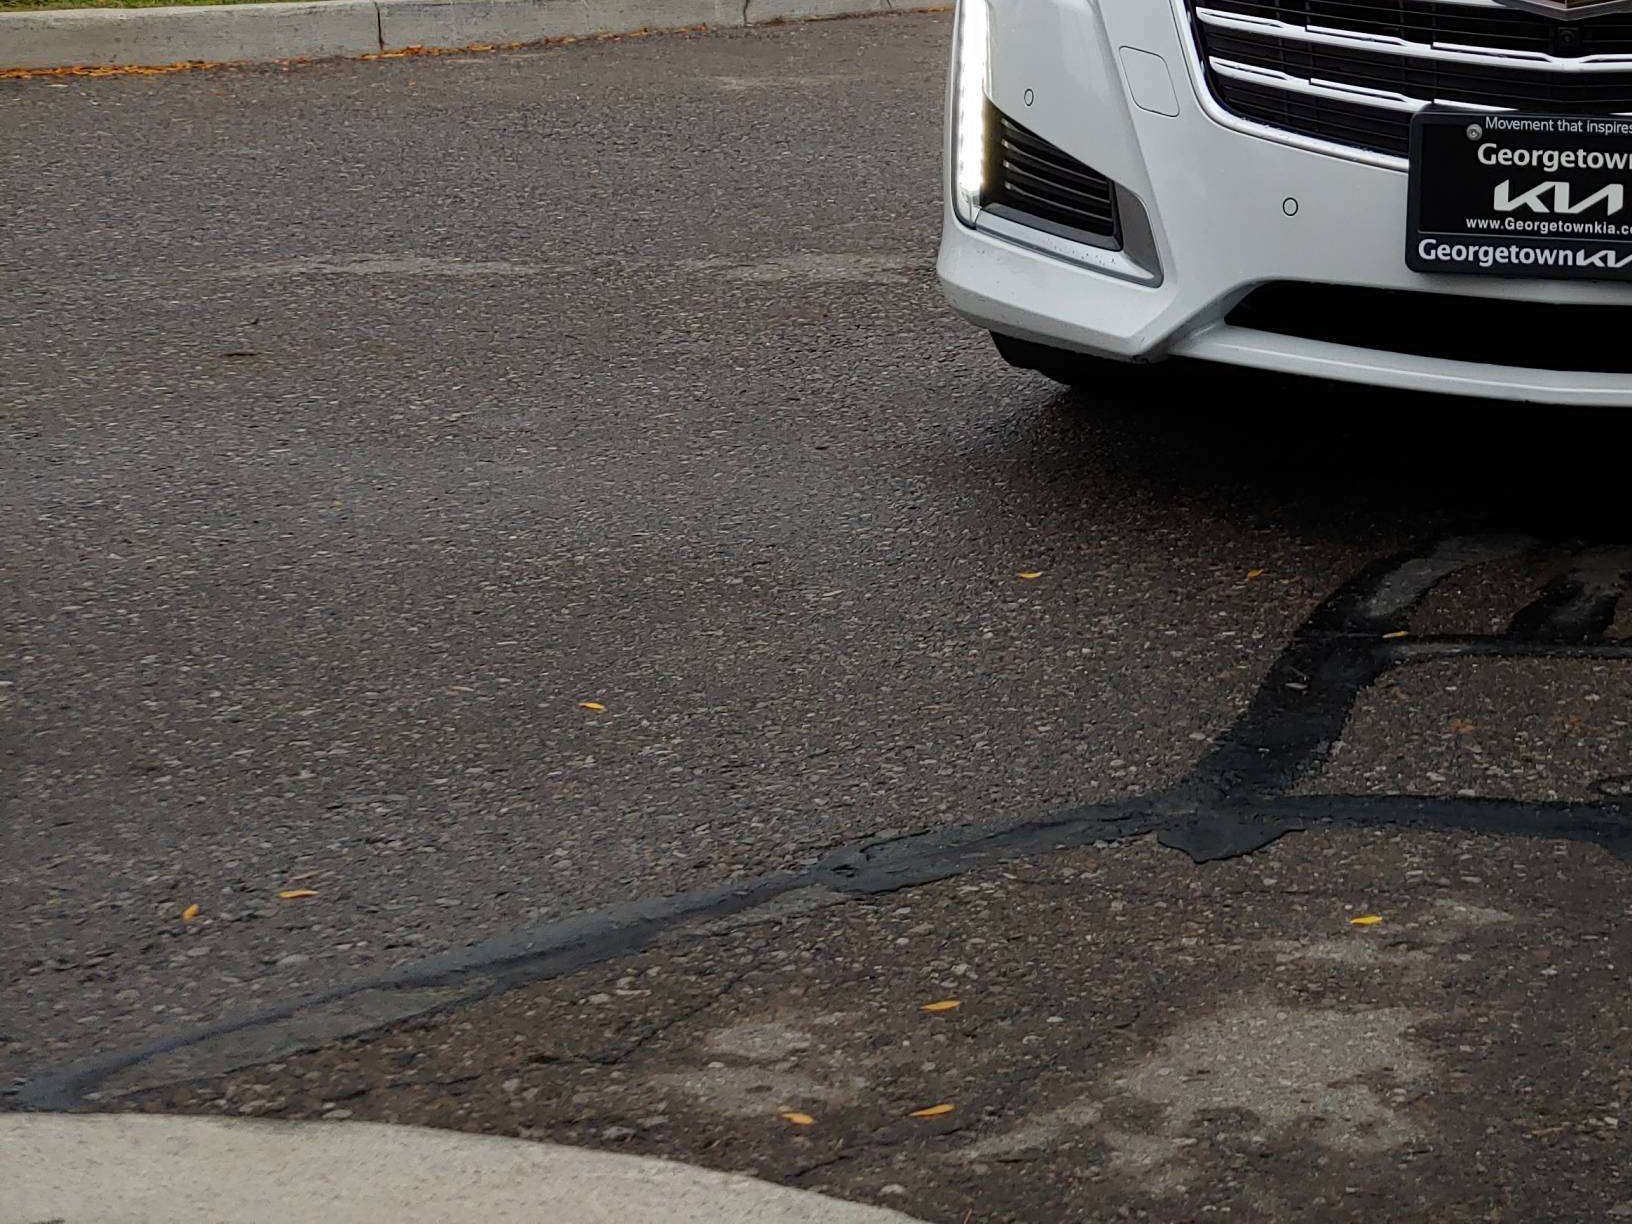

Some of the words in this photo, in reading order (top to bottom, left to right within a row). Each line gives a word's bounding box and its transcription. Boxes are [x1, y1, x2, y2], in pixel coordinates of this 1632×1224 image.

[1485, 116, 1554, 132] Movement
[1556, 119, 1583, 133] that
[1493, 179, 1624, 216] KIA
